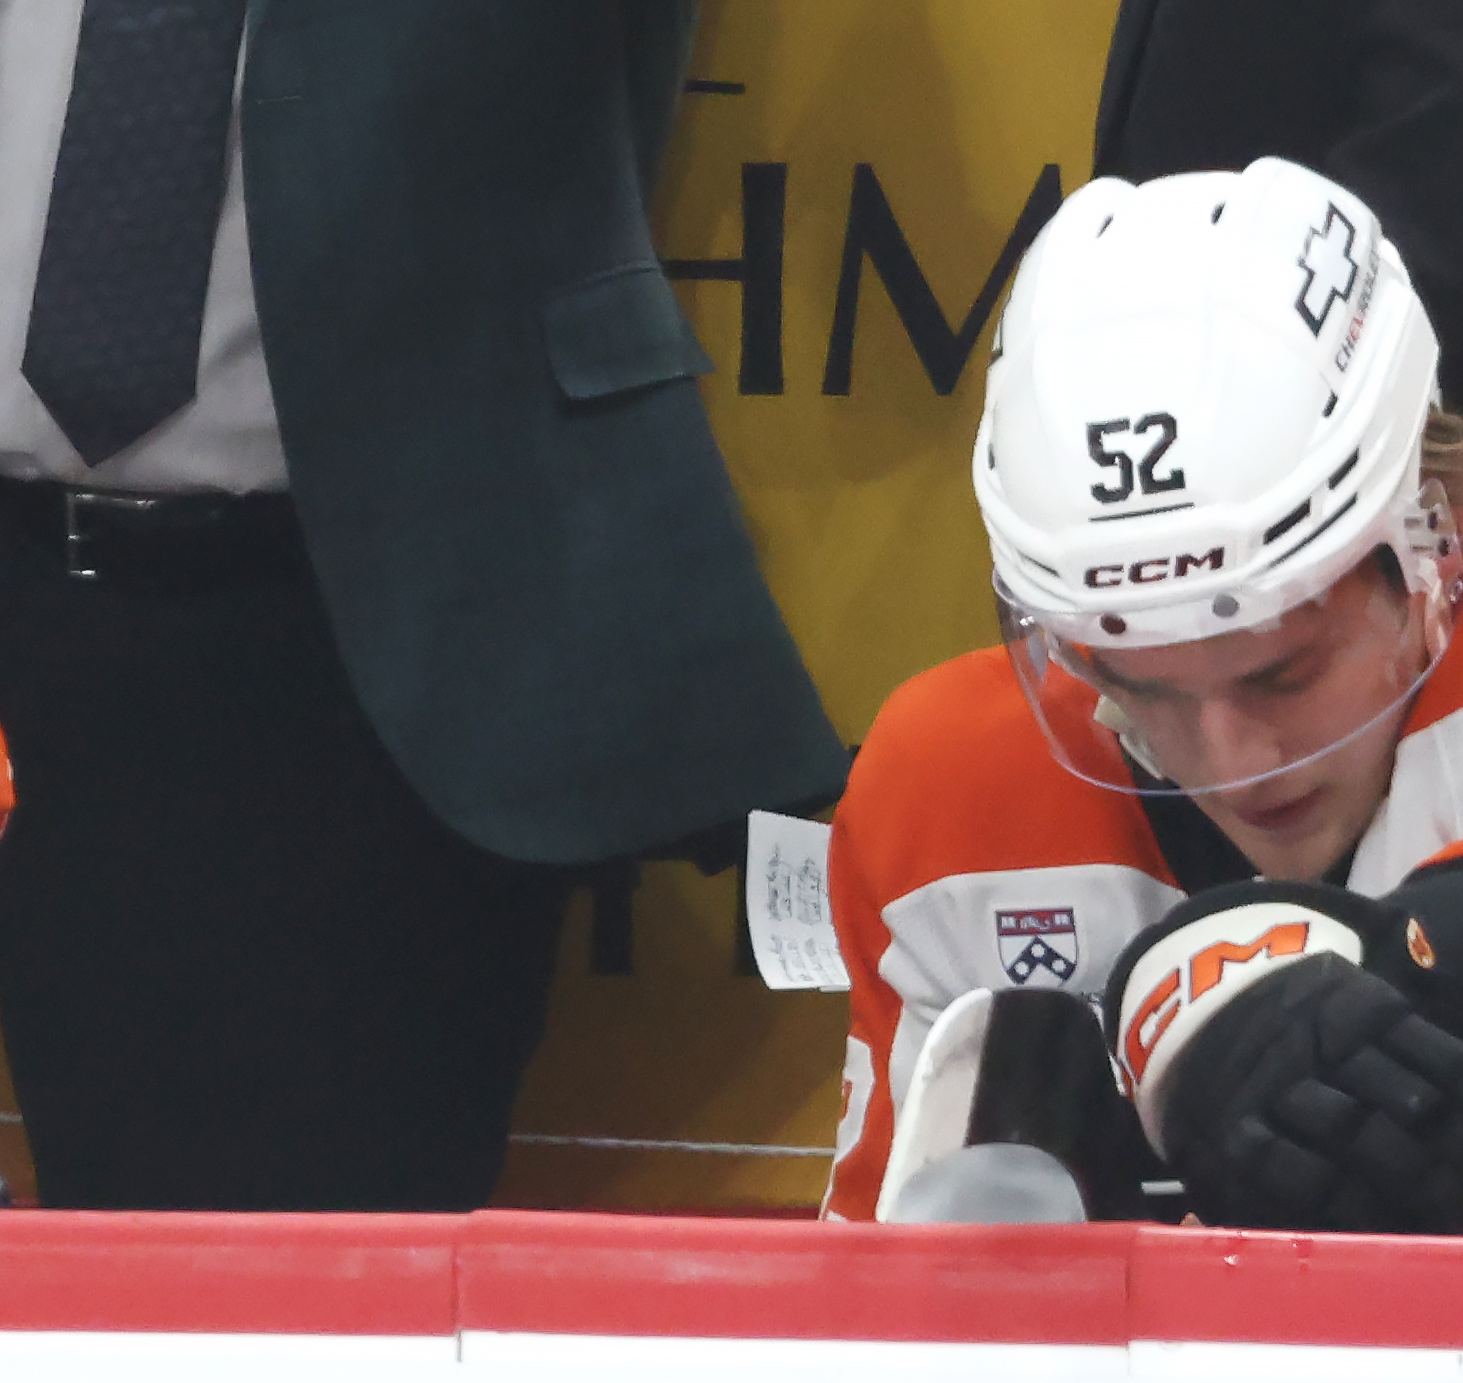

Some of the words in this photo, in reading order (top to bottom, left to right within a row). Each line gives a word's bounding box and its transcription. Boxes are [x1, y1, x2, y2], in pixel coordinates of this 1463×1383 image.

[1086, 412, 1186, 504] 52
[1084, 547, 1225, 589] CCM
[1122, 921, 1310, 1090] CM
